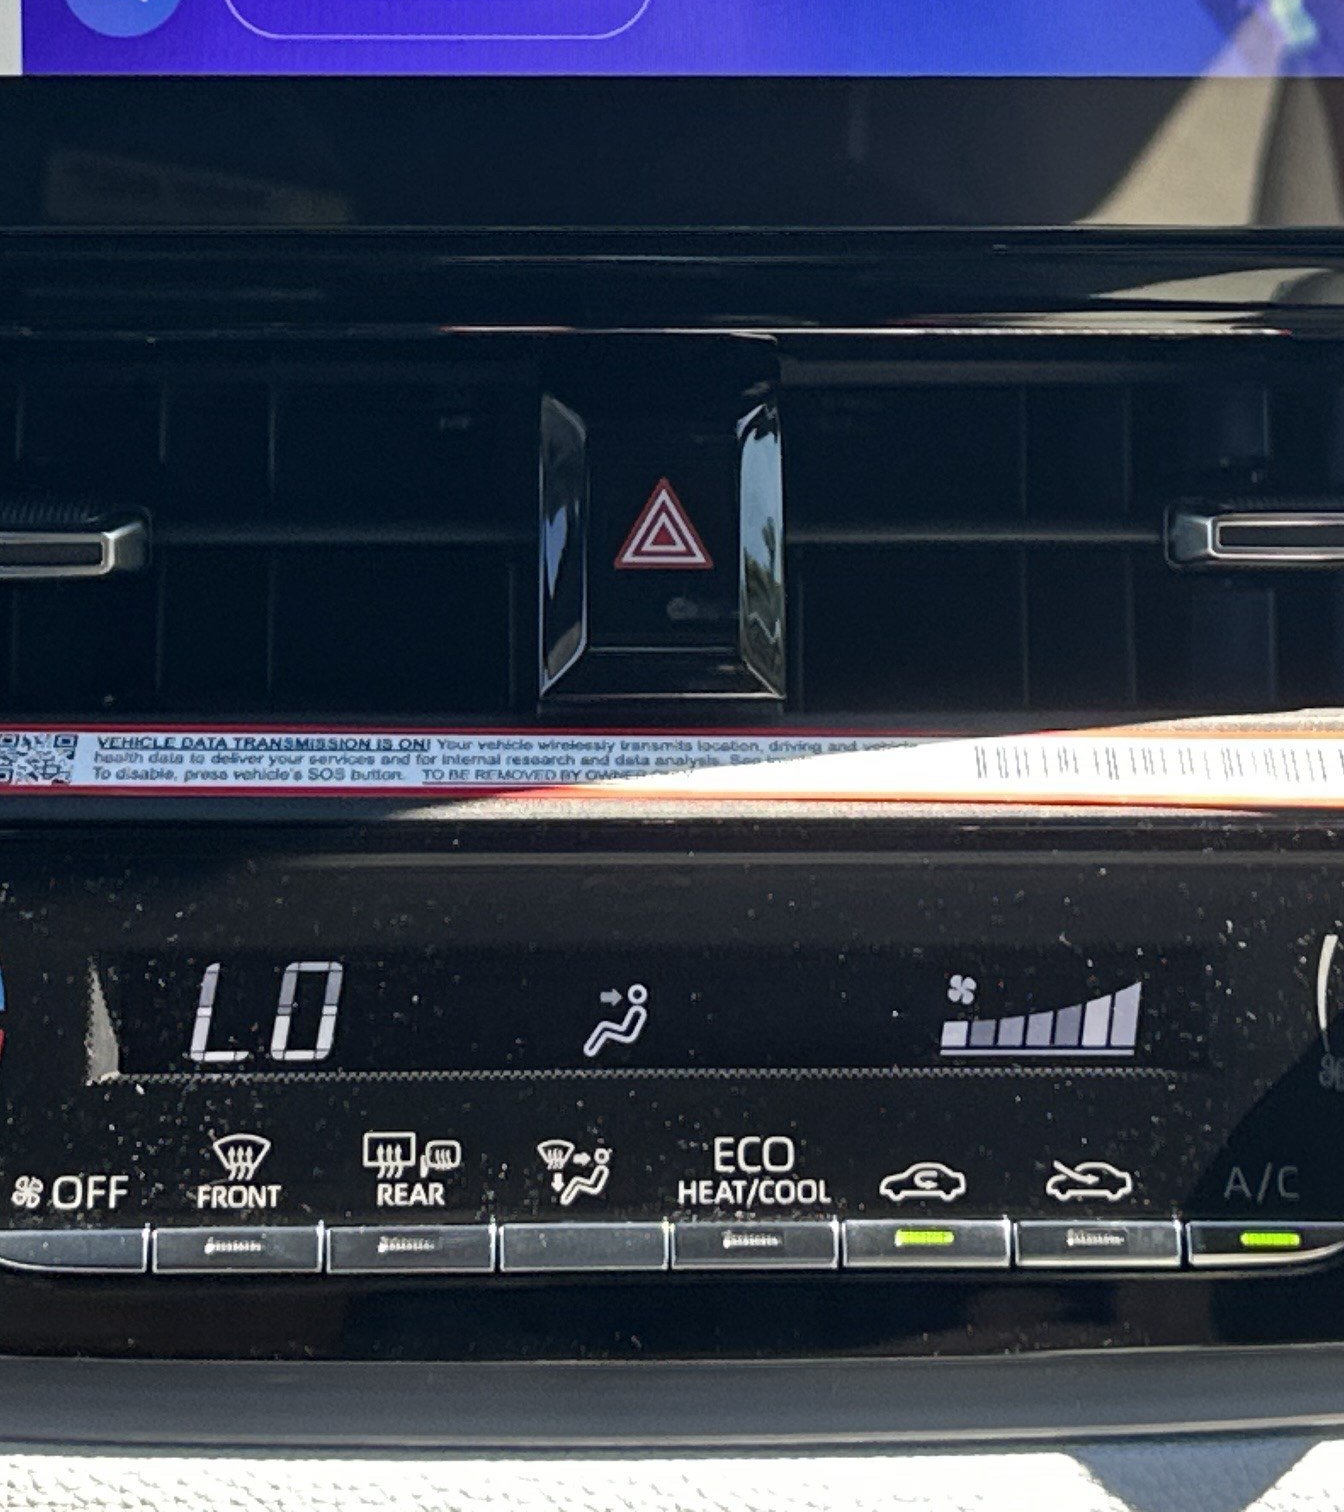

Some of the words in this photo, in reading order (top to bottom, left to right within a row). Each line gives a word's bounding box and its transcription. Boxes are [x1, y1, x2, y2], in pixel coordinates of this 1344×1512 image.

[94, 751, 144, 765] health
[148, 751, 184, 765] data
[189, 752, 205, 765] to
[211, 752, 263, 765] deliver
[268, 754, 304, 767] your
[309, 753, 375, 766] services
[380, 753, 410, 766] and
[416, 753, 437, 766] for
[441, 753, 501, 766] internal
[506, 753, 575, 766] research
[580, 753, 610, 766] and
[615, 754, 650, 766] data
[98, 737, 178, 750] VEHICLE
[182, 737, 228, 750] DATA
[233, 737, 371, 751] TRANSMISSION
[376, 738, 394, 751] IS
[399, 738, 431, 752] ON!
[437, 738, 471, 751] Your
[478, 738, 533, 751] vehicle
[538, 739, 615, 753] wirelessly
[620, 739, 693, 752] transmits
[769, 740, 823, 754] driving
[828, 741, 857, 753] and
[93, 766, 112, 781] To
[116, 766, 178, 782] disable,
[183, 769, 228, 782] press
[233, 767, 302, 782] vehicle's
[307, 767, 346, 781] SOS
[351, 768, 403, 781] button.
[422, 769, 445, 781] TO
[449, 769, 470, 781] BE
[475, 769, 557, 781] REMOVED
[560, 769, 580, 782] BY
[190, 961, 344, 1062] LO
[713, 1136, 794, 1173] ECO
[52, 1175, 129, 1209] OFF
[197, 1185, 282, 1209] FRONT
[376, 1182, 445, 1207] REAR
[677, 1178, 831, 1207] HEAT/COOL
[1224, 1165, 1300, 1202] A/C
